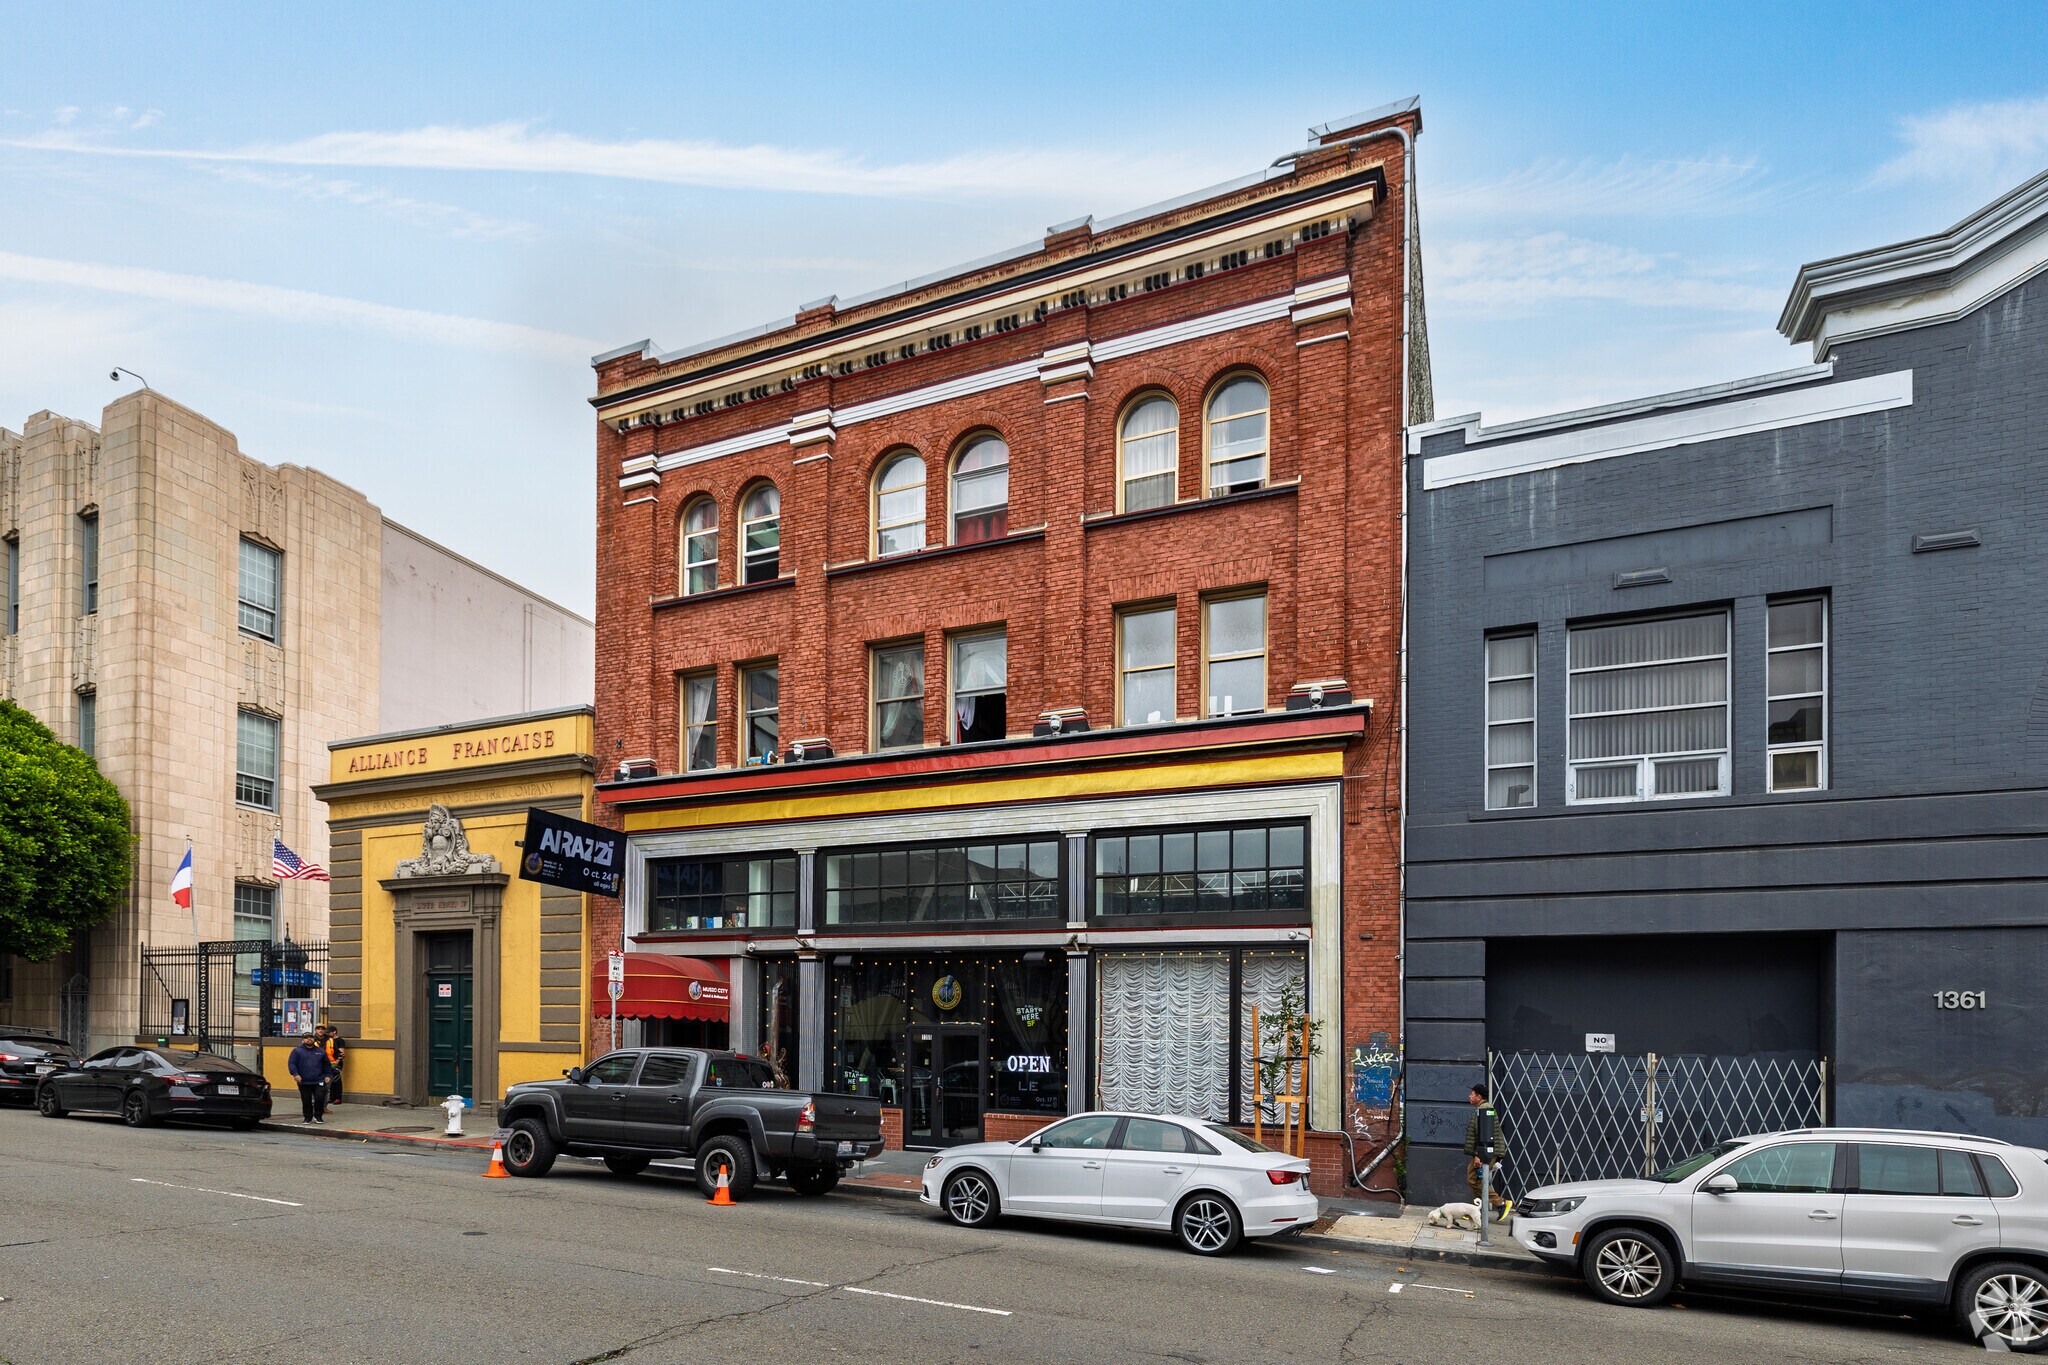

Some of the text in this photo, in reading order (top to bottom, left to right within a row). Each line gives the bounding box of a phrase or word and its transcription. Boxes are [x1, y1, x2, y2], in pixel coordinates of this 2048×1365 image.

[348, 730, 555, 773] ALLIANCE FRANCAISE
[373, 798, 419, 812] FRANCISCO
[463, 786, 504, 802] ELECTRIC
[508, 782, 555, 798] COMPANY
[602, 871, 612, 881] 24
[1933, 990, 1986, 1009] 1361
[1022, 1013, 1040, 1021] HERE
[1007, 1055, 1051, 1073] OPEN
